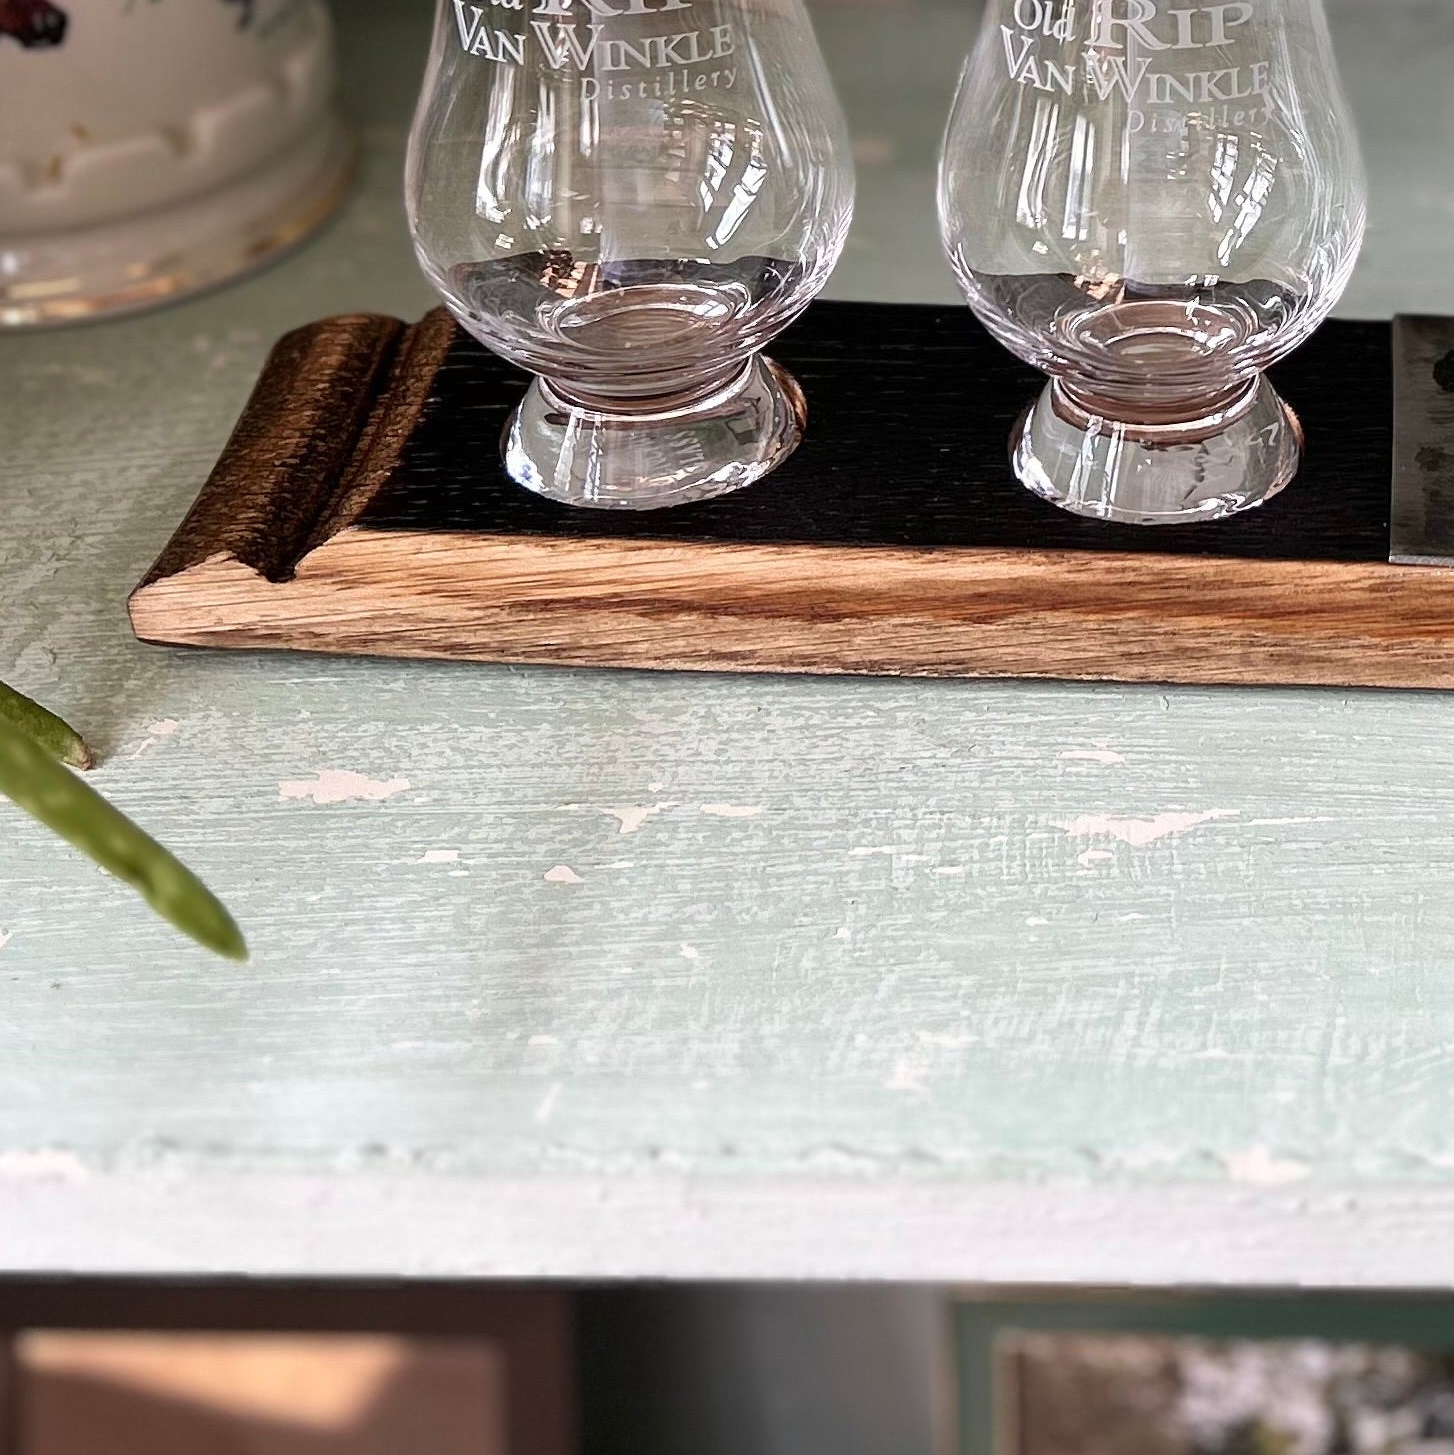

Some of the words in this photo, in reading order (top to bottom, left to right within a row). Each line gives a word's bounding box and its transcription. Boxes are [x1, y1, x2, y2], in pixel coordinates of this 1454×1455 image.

[529, 19, 736, 72] WINKLE
[1000, 24, 1077, 96] VAN
[1081, 50, 1270, 104] WINKLE
[581, 67, 738, 102] Distillery
